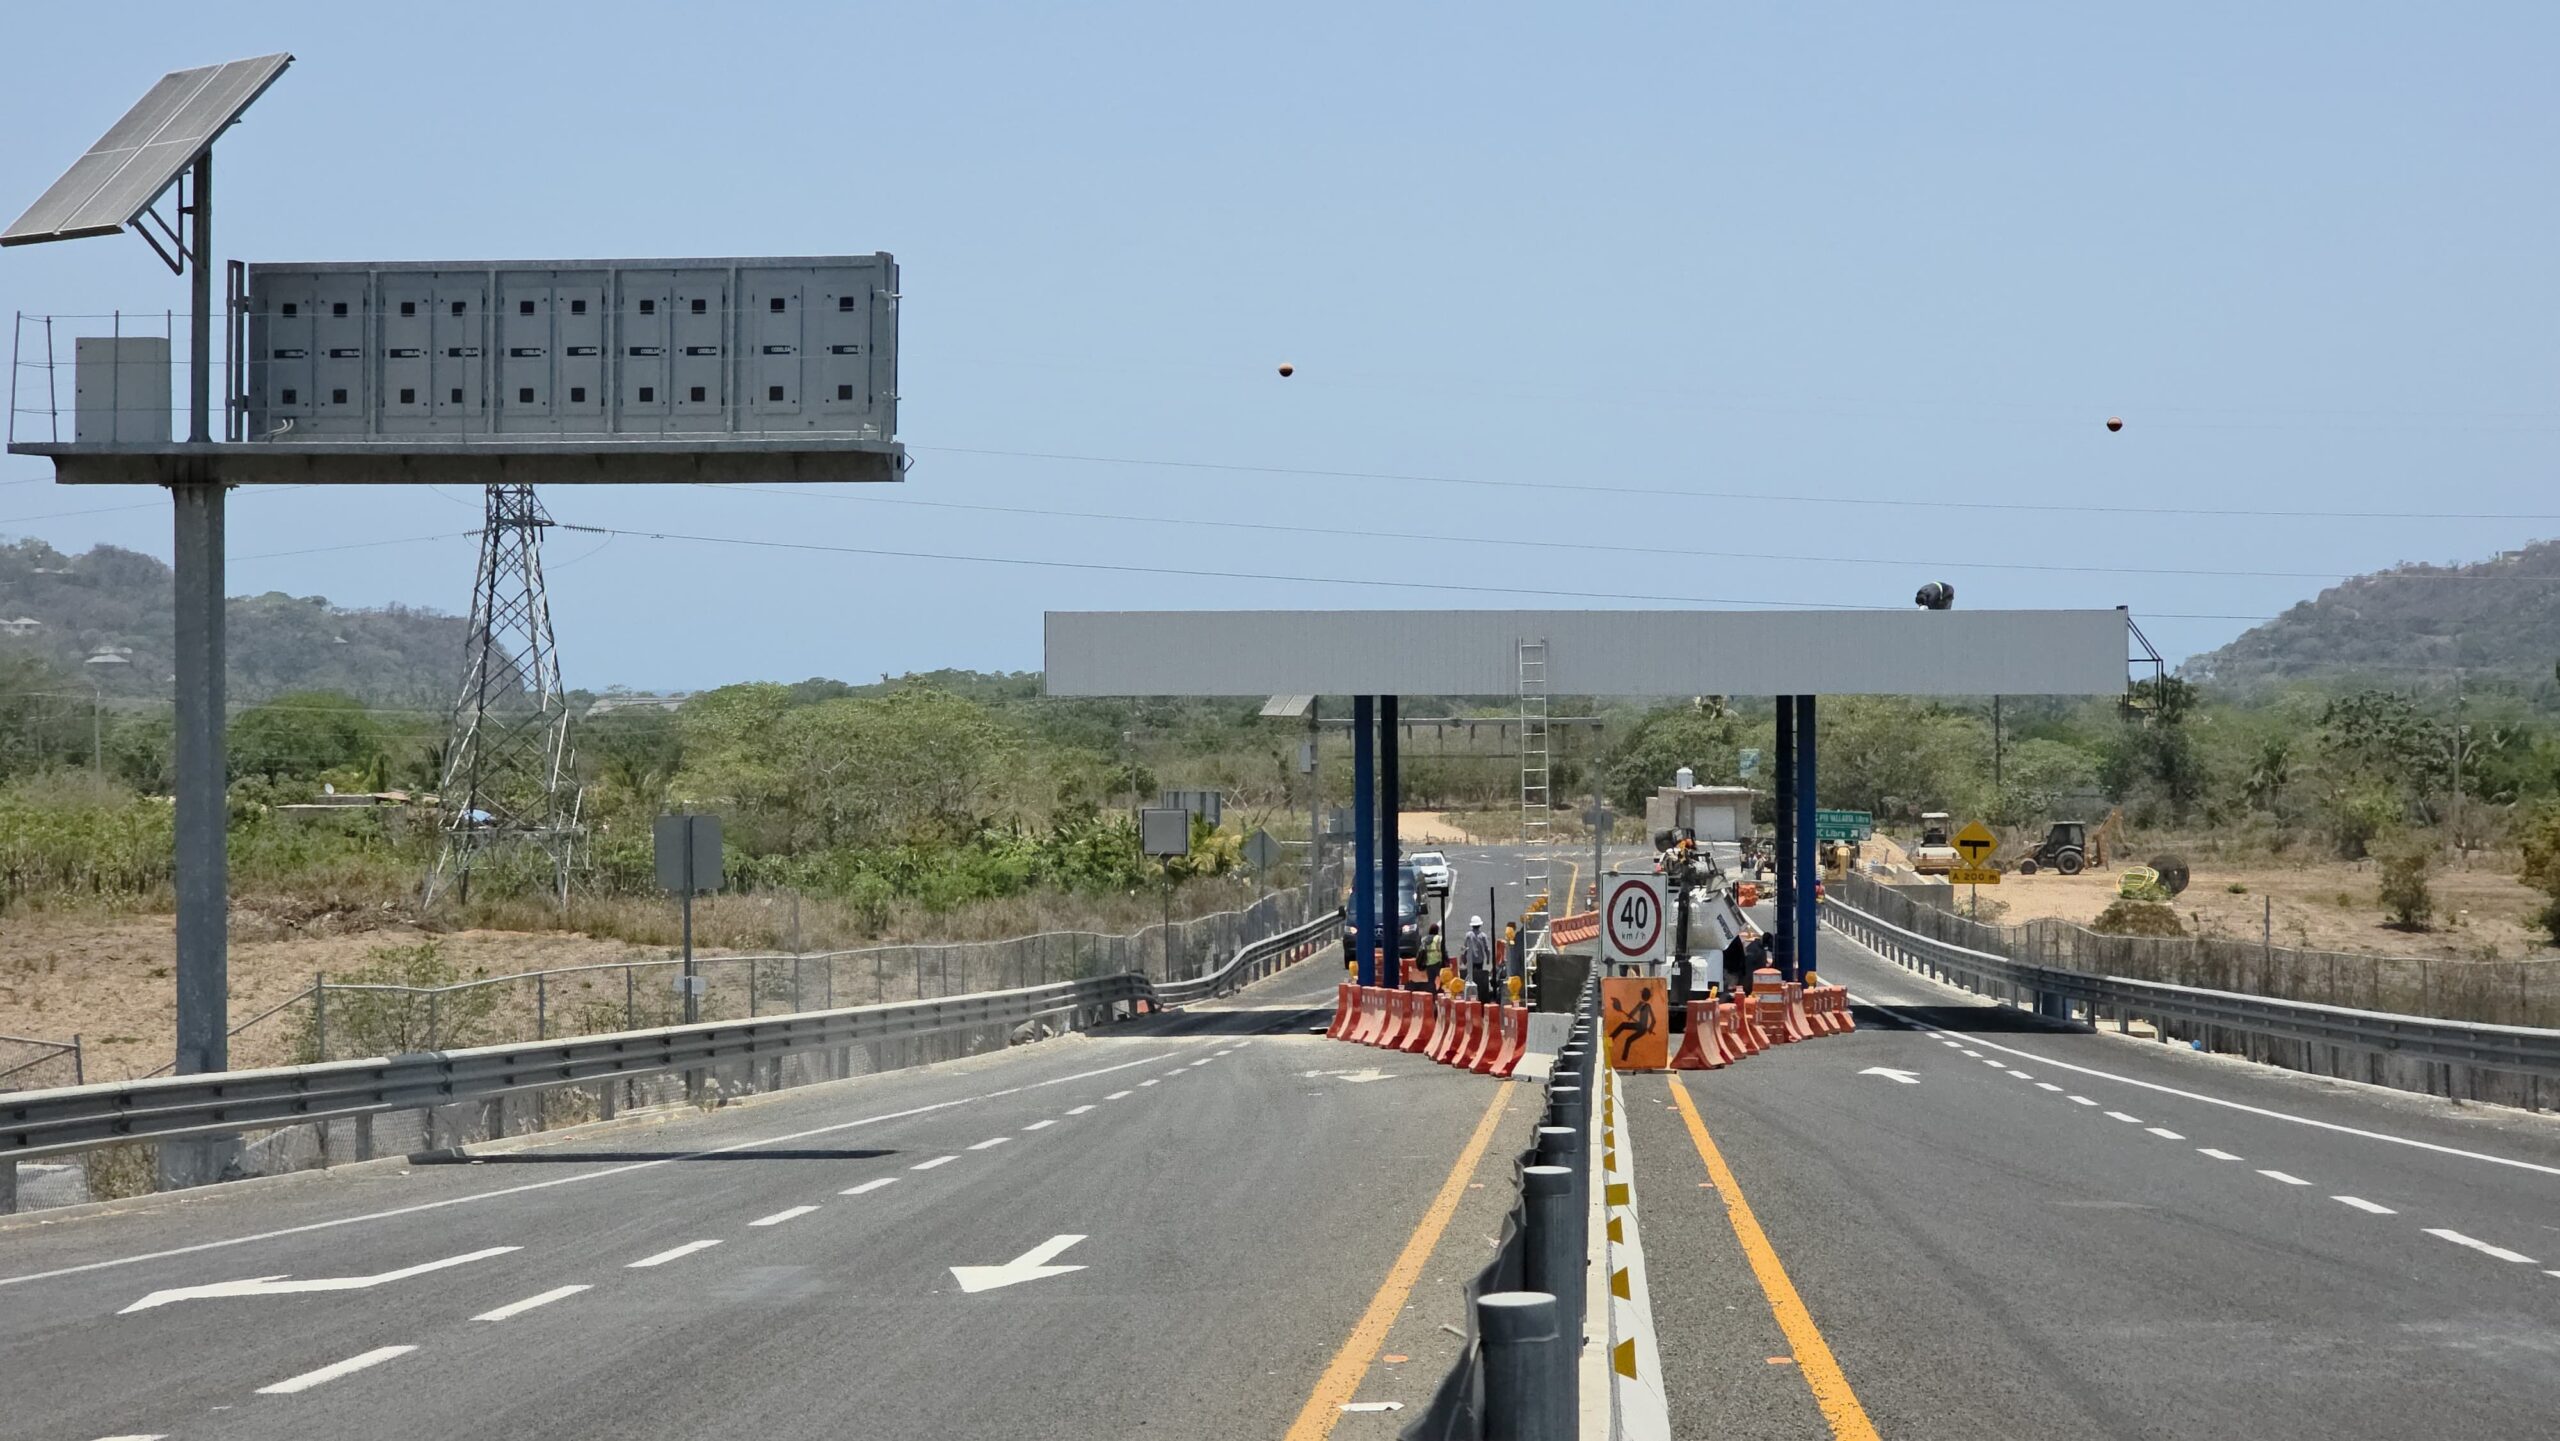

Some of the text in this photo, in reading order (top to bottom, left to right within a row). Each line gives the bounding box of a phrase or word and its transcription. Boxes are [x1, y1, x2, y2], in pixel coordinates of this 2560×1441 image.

[1826, 829, 1846, 838] Libre
[1952, 872, 1959, 880] A
[1964, 872, 1984, 880] 200
[1620, 896, 1648, 928] 40
